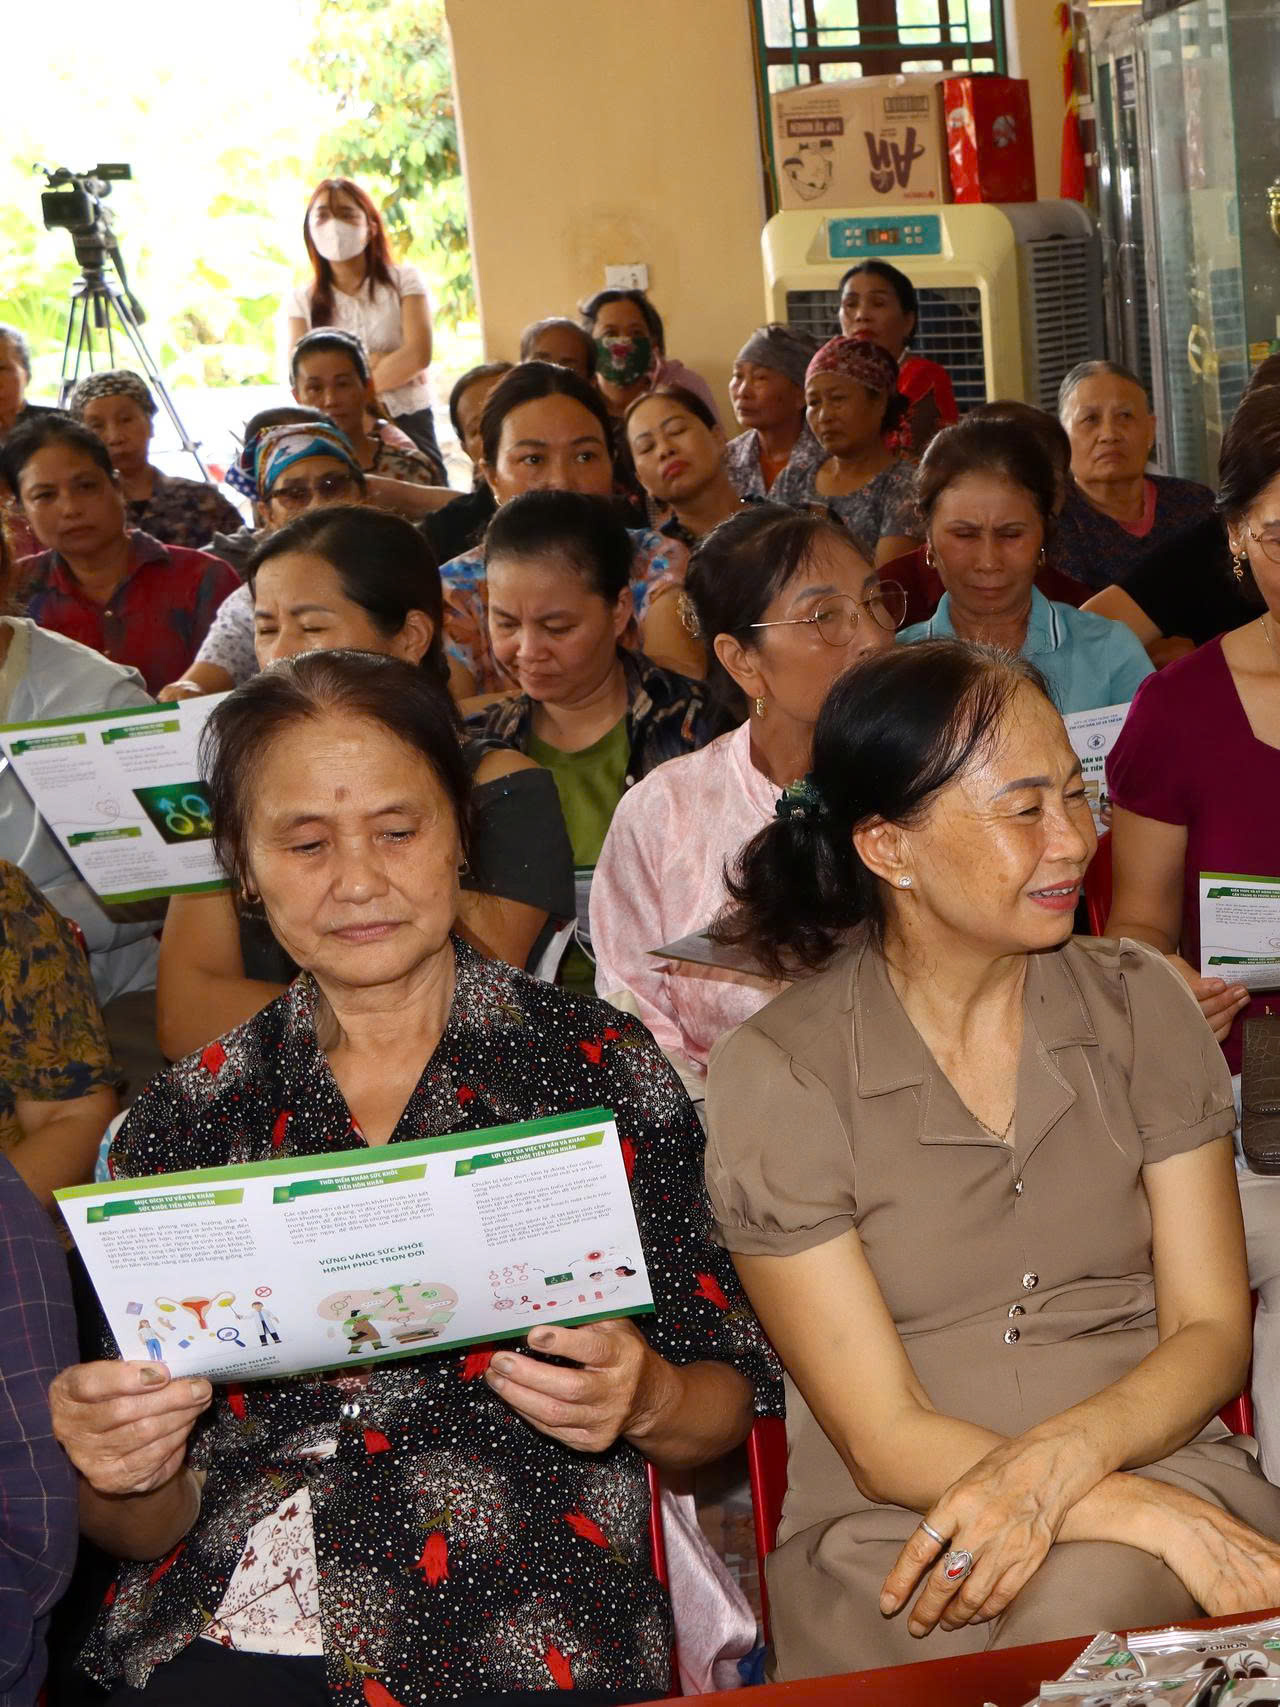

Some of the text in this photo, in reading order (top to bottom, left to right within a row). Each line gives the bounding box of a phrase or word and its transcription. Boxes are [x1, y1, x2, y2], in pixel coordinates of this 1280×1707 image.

[319, 1241, 424, 1265] VỮNG VÀNG SỨC KHỎE
[322, 1249, 425, 1274] HẠNH PHÚC TRỌN ĐỜI
[1209, 1641, 1248, 1651] ORION
